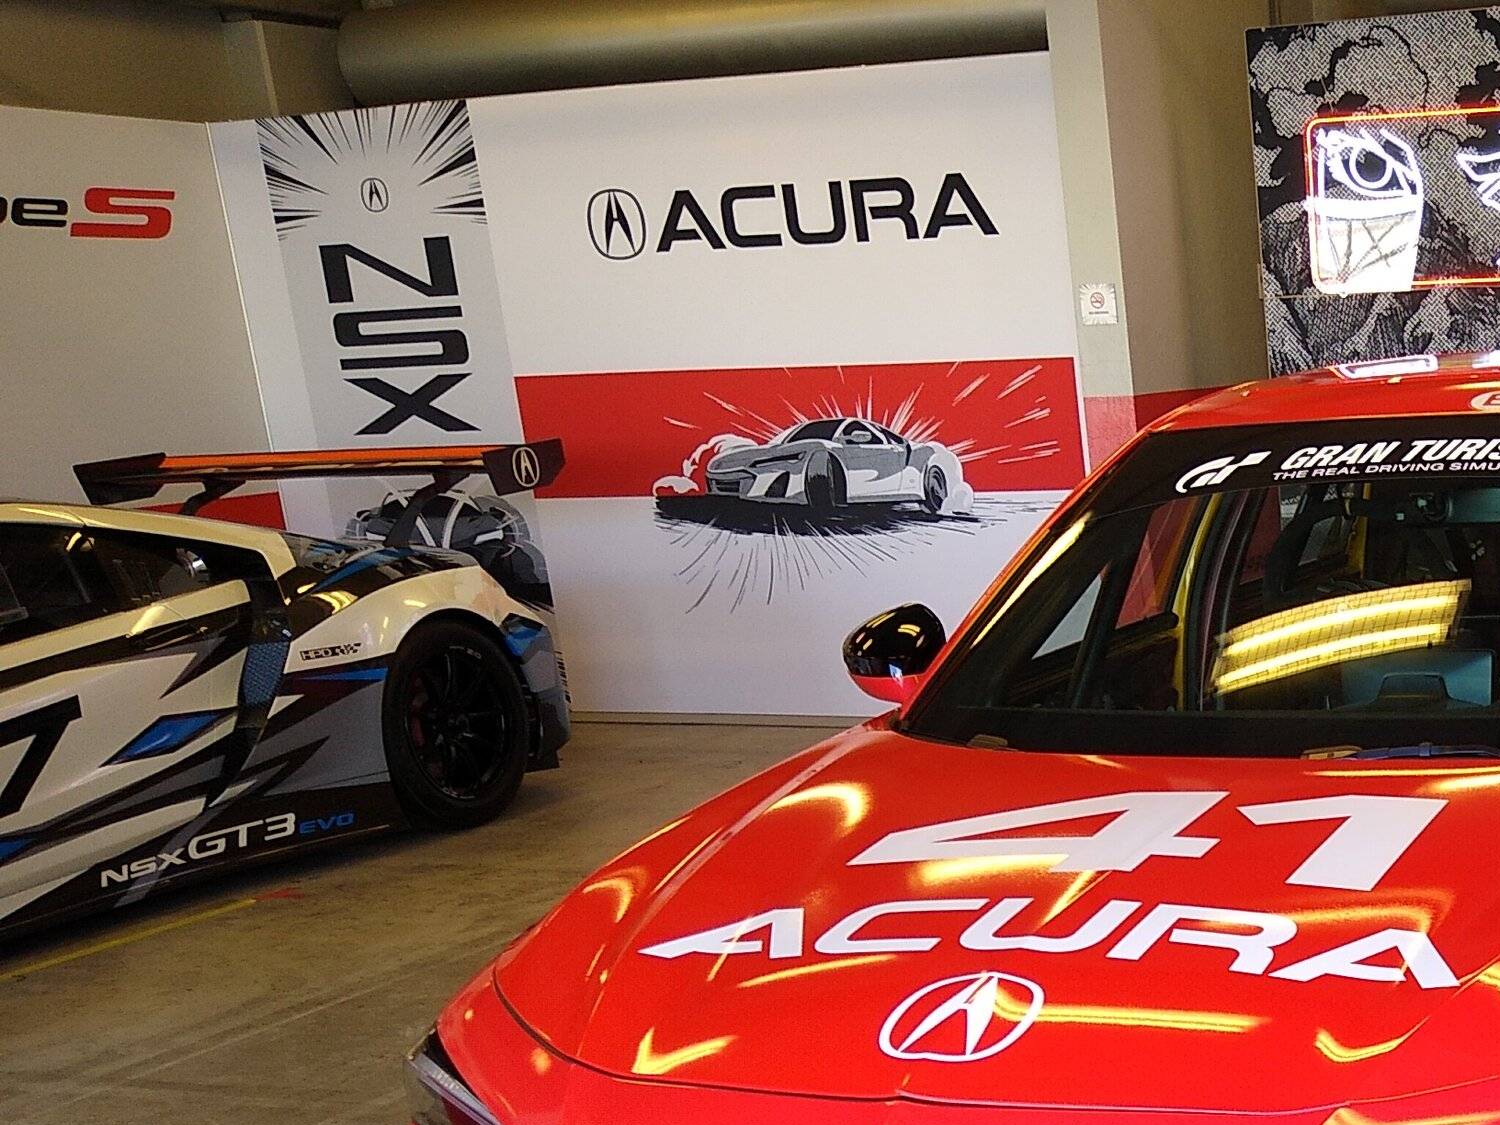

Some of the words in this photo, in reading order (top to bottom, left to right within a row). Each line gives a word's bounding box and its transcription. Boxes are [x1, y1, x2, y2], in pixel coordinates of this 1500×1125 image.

[656, 173, 999, 253] ACURA
[319, 236, 481, 436] NSX
[1273, 470, 1307, 481] THE
[1311, 467, 1360, 478] REAL
[1364, 462, 1445, 474] DRIVING
[1281, 441, 1402, 471] GRAN
[301, 648, 333, 660] HPD
[846, 790, 1449, 892] 41
[637, 896, 1461, 988] ACURA
